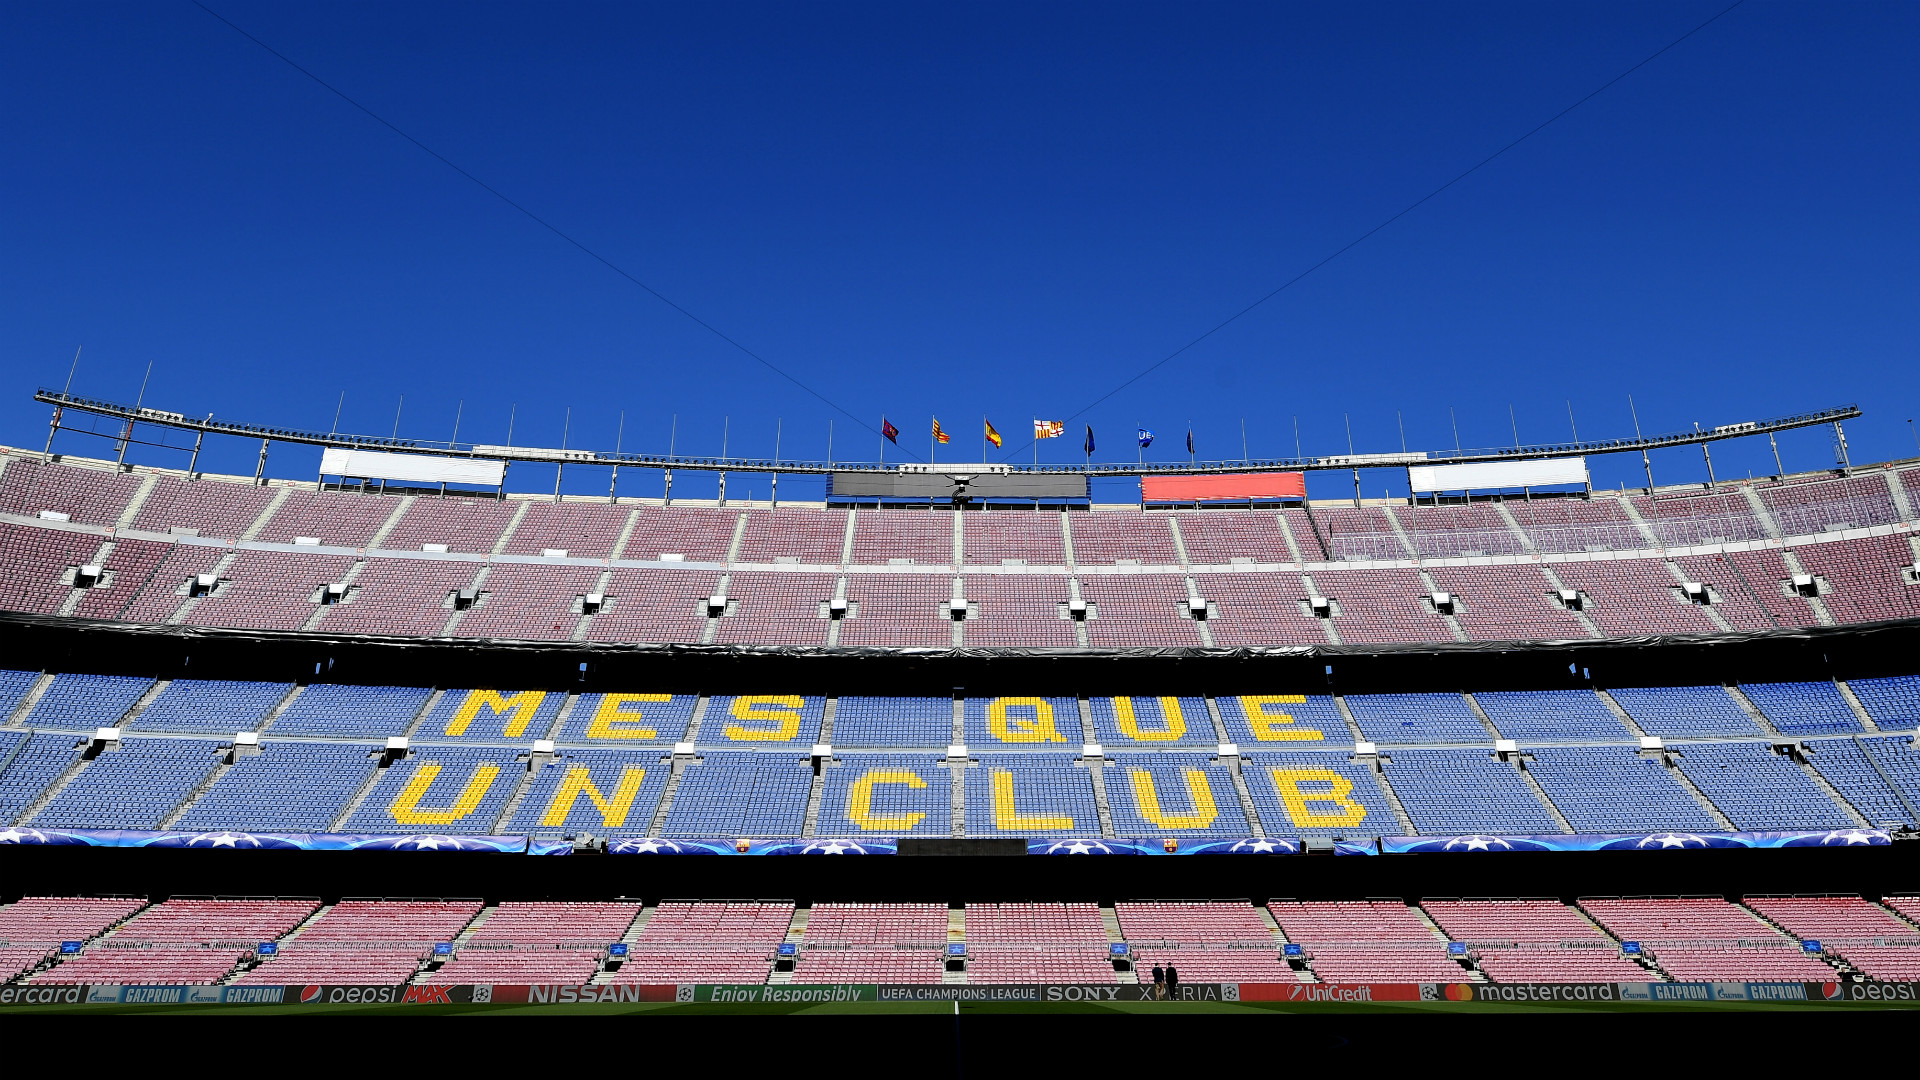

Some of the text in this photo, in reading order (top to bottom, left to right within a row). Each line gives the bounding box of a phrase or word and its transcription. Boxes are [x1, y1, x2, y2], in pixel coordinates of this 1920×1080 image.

[446, 690, 1325, 742] MES QUE
[390, 766, 1367, 830] UN CLUB
[125, 988, 182, 1003] GAZPROM
[226, 988, 282, 1003] GAZPROM
[329, 985, 458, 1003] pepsi MAX
[528, 985, 641, 1003] NISSAN
[762, 985, 862, 1002] Responsibly
[882, 988, 1036, 1000] UEFA CHAMPIONS LEAGUE
[1047, 986, 1121, 1001] SONY
[1305, 984, 1373, 1001] UniCredit
[1478, 984, 1613, 1001] mastercard
[1655, 985, 1709, 999] GAZPROM
[1750, 985, 1804, 999] GAZPROM
[1851, 982, 1916, 1001] pepsi
